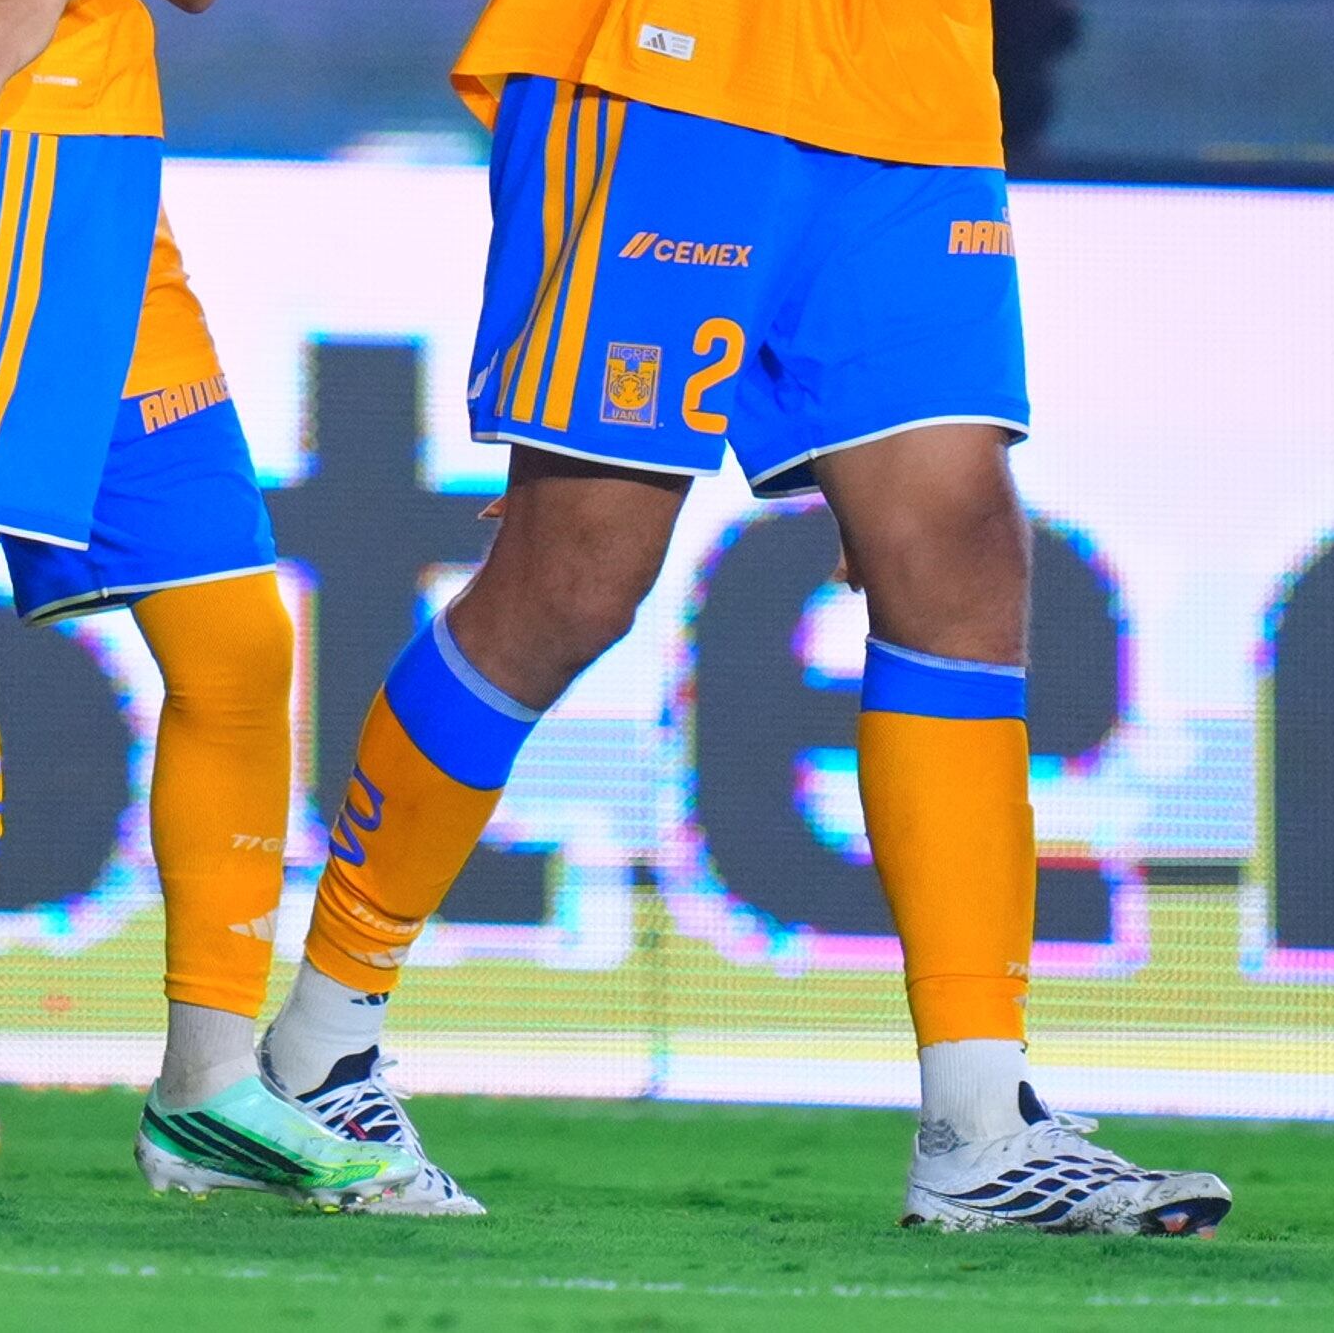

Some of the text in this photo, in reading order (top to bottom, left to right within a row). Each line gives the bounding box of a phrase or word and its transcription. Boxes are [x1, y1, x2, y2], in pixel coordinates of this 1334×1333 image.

[653, 238, 753, 268] CEMEX
[610, 347, 658, 363] TIGRES
[681, 317, 747, 435] 2
